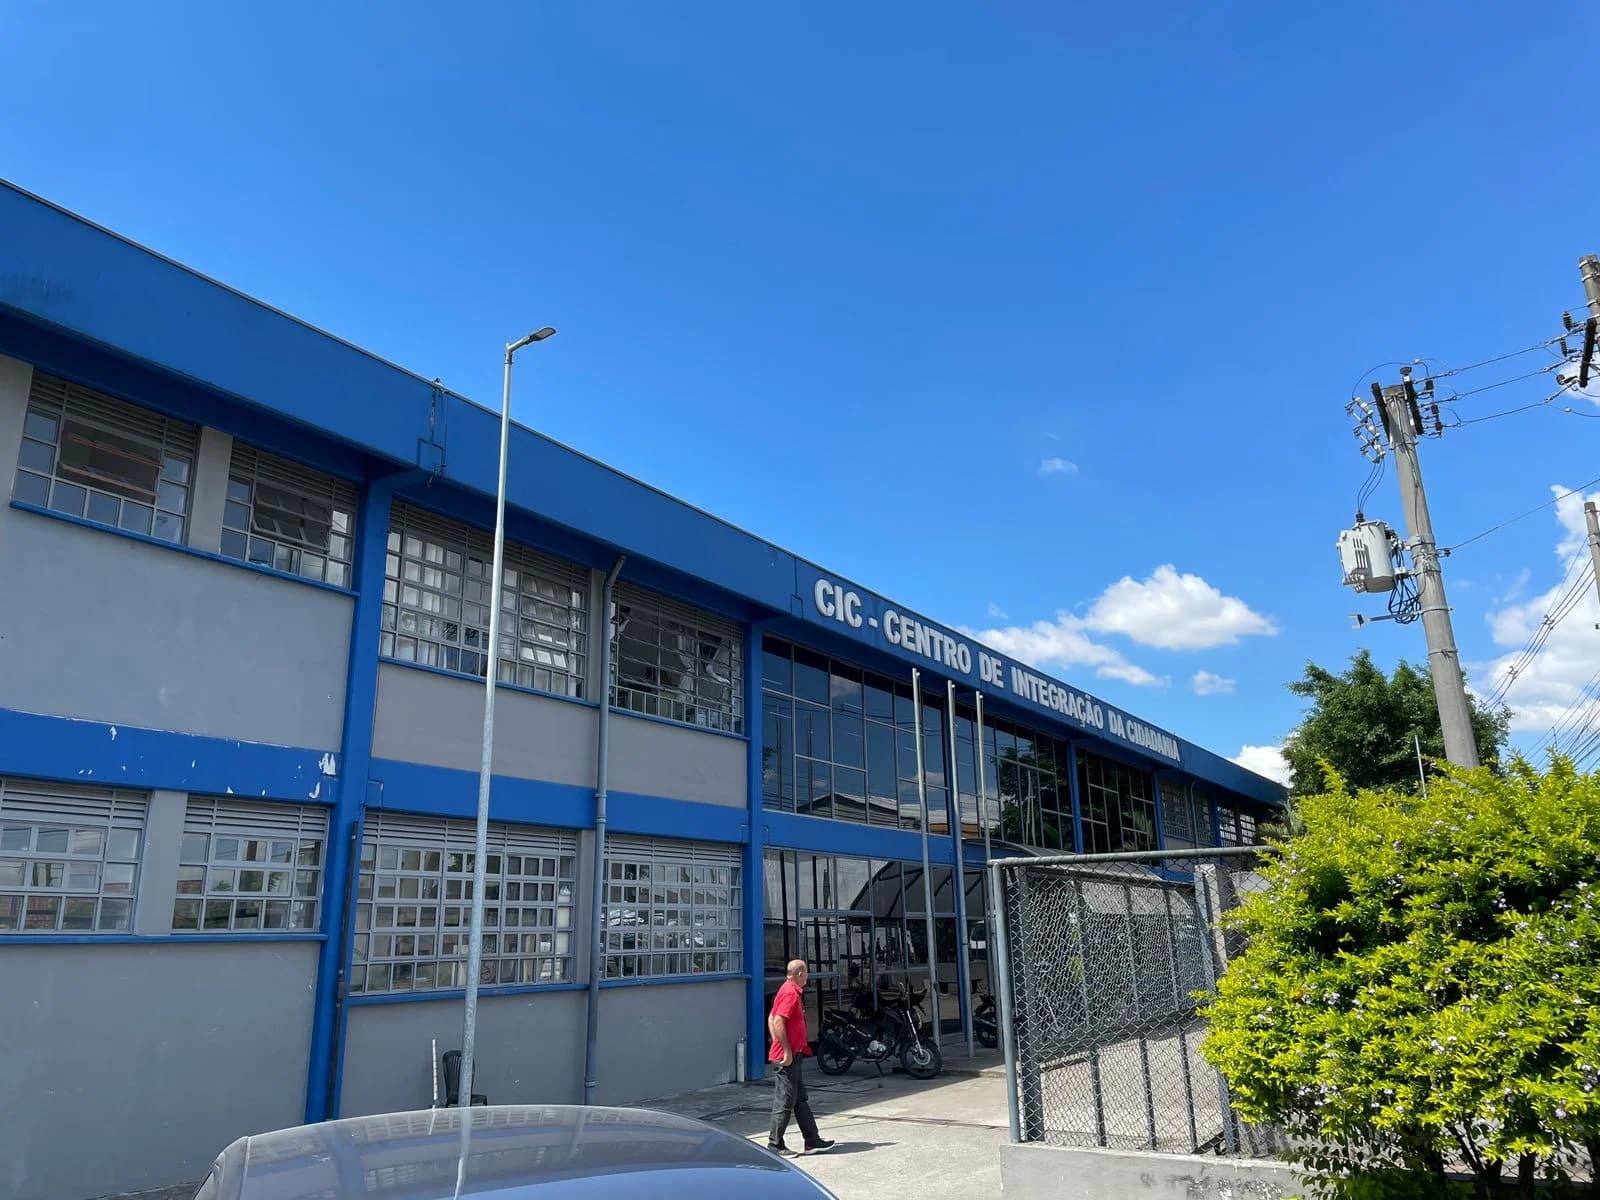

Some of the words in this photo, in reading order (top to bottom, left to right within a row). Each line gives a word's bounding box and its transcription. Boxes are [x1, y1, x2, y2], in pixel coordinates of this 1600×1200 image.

[814, 578, 862, 629] CIC
[868, 618, 878, 628] -
[883, 609, 972, 674] CENTRO
[978, 652, 1004, 689] DE
[1011, 667, 1104, 729] INTEGRAÇÃO
[1108, 711, 1126, 740] DA
[1127, 720, 1180, 761] CIDADANIA
